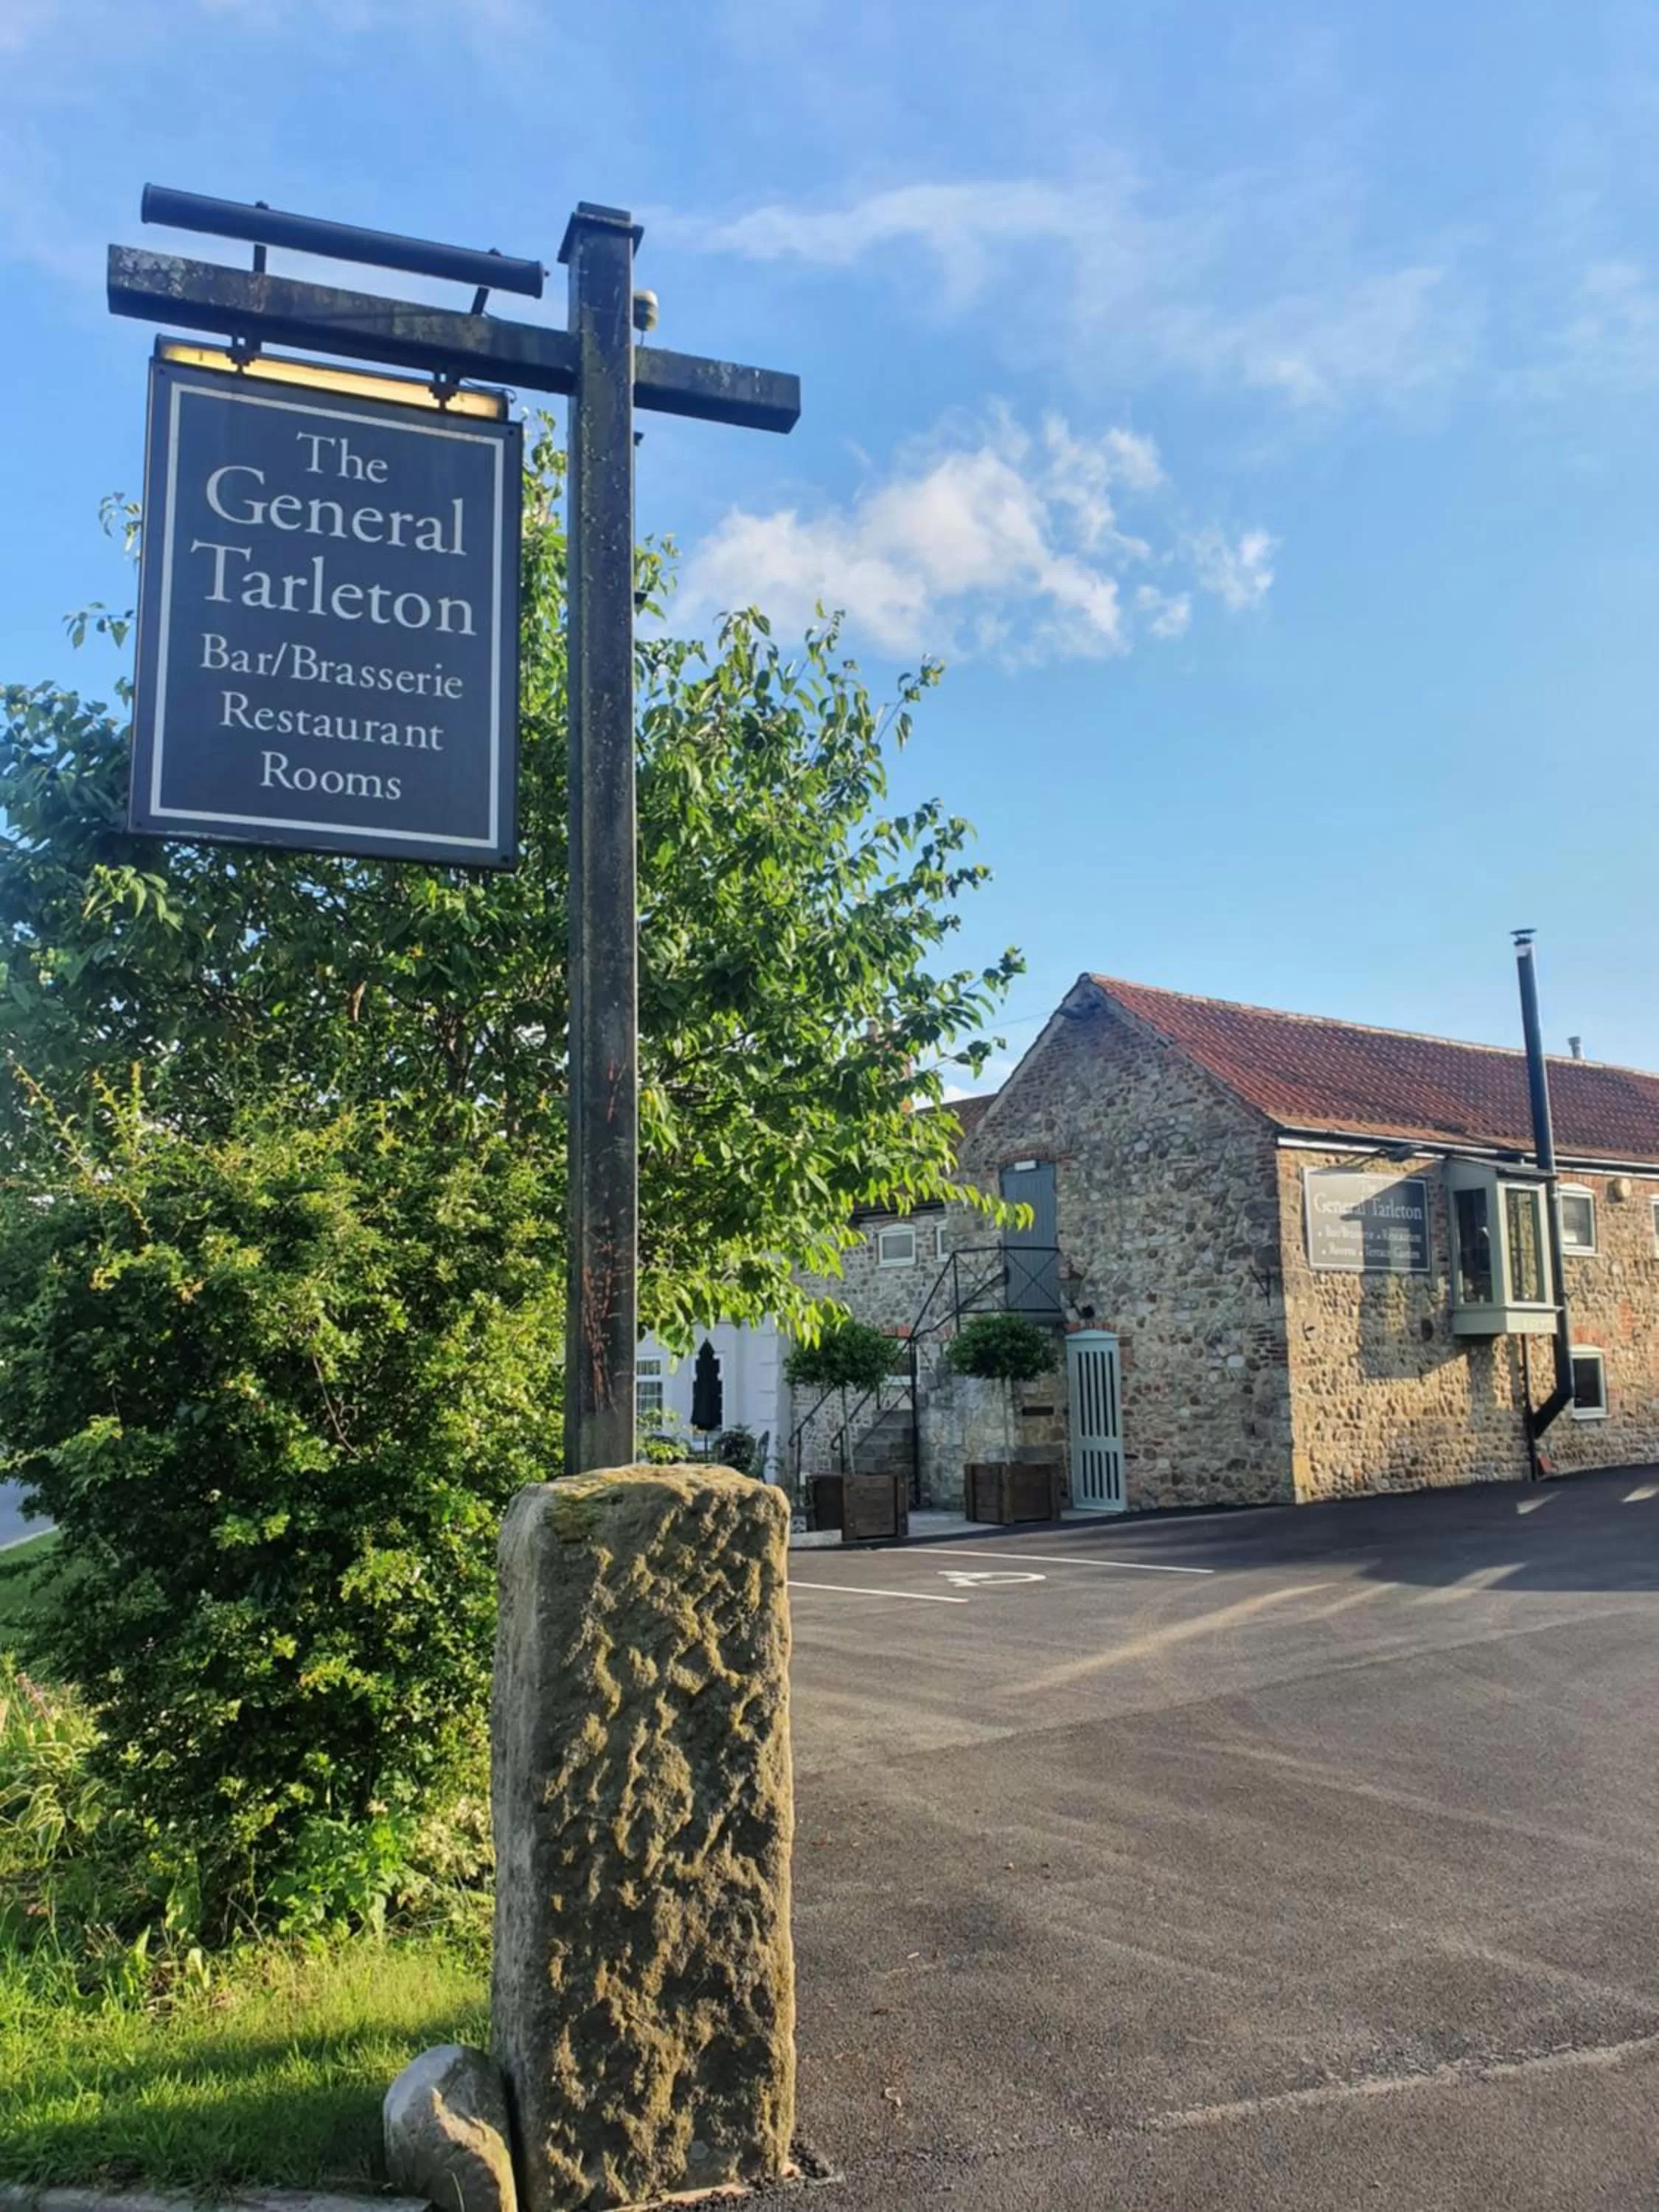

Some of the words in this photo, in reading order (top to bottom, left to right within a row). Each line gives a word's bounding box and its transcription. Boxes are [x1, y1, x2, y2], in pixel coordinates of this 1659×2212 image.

[296, 431, 389, 484] The
[206, 465, 468, 556] General
[189, 539, 478, 636] Tarleton
[201, 633, 464, 700] Bar/Brasserie
[220, 691, 445, 751] Restaurant
[260, 751, 403, 801] Rooms
[1371, 1196, 1423, 1221] Tarleton
